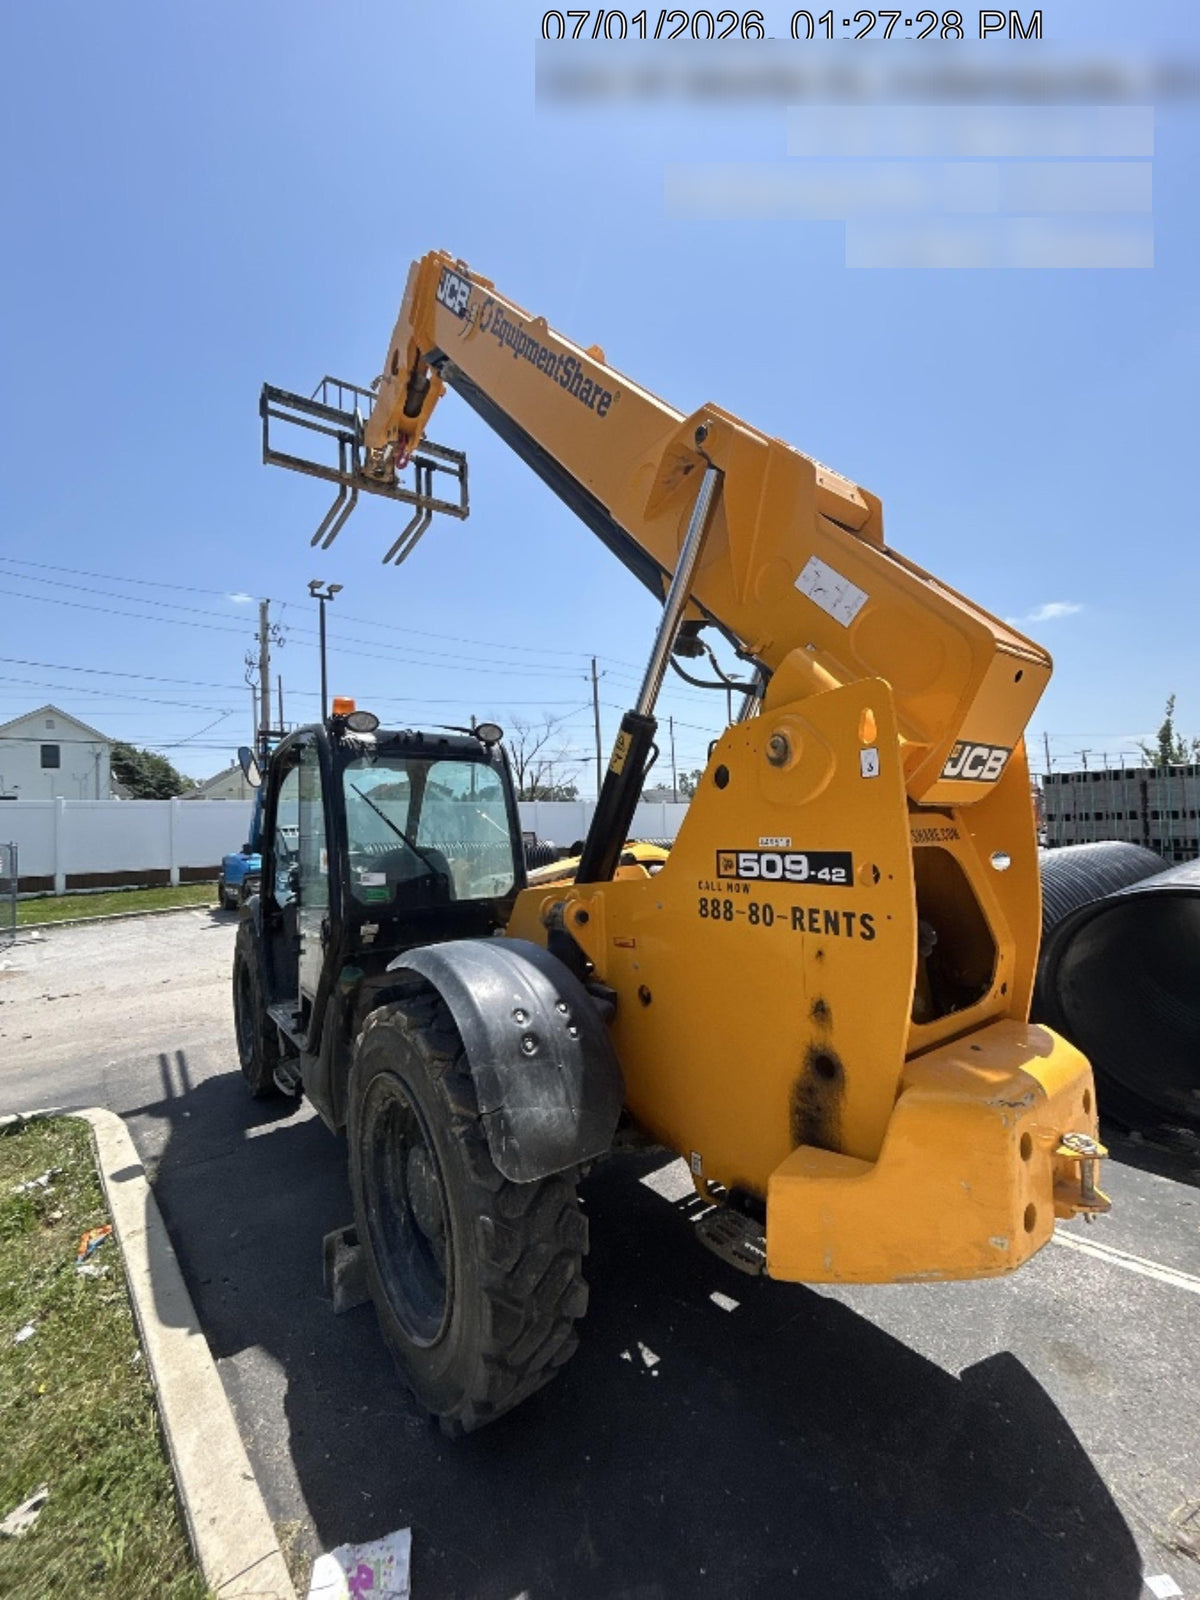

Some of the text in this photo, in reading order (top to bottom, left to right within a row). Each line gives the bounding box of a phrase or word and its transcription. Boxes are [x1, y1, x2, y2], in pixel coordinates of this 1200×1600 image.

[436, 270, 471, 315] JCB
[490, 307, 613, 419] EquipmentShare
[943, 745, 1010, 781] JCB
[698, 880, 723, 892] CALL
[698, 896, 876, 941] 888-80-RENTS
